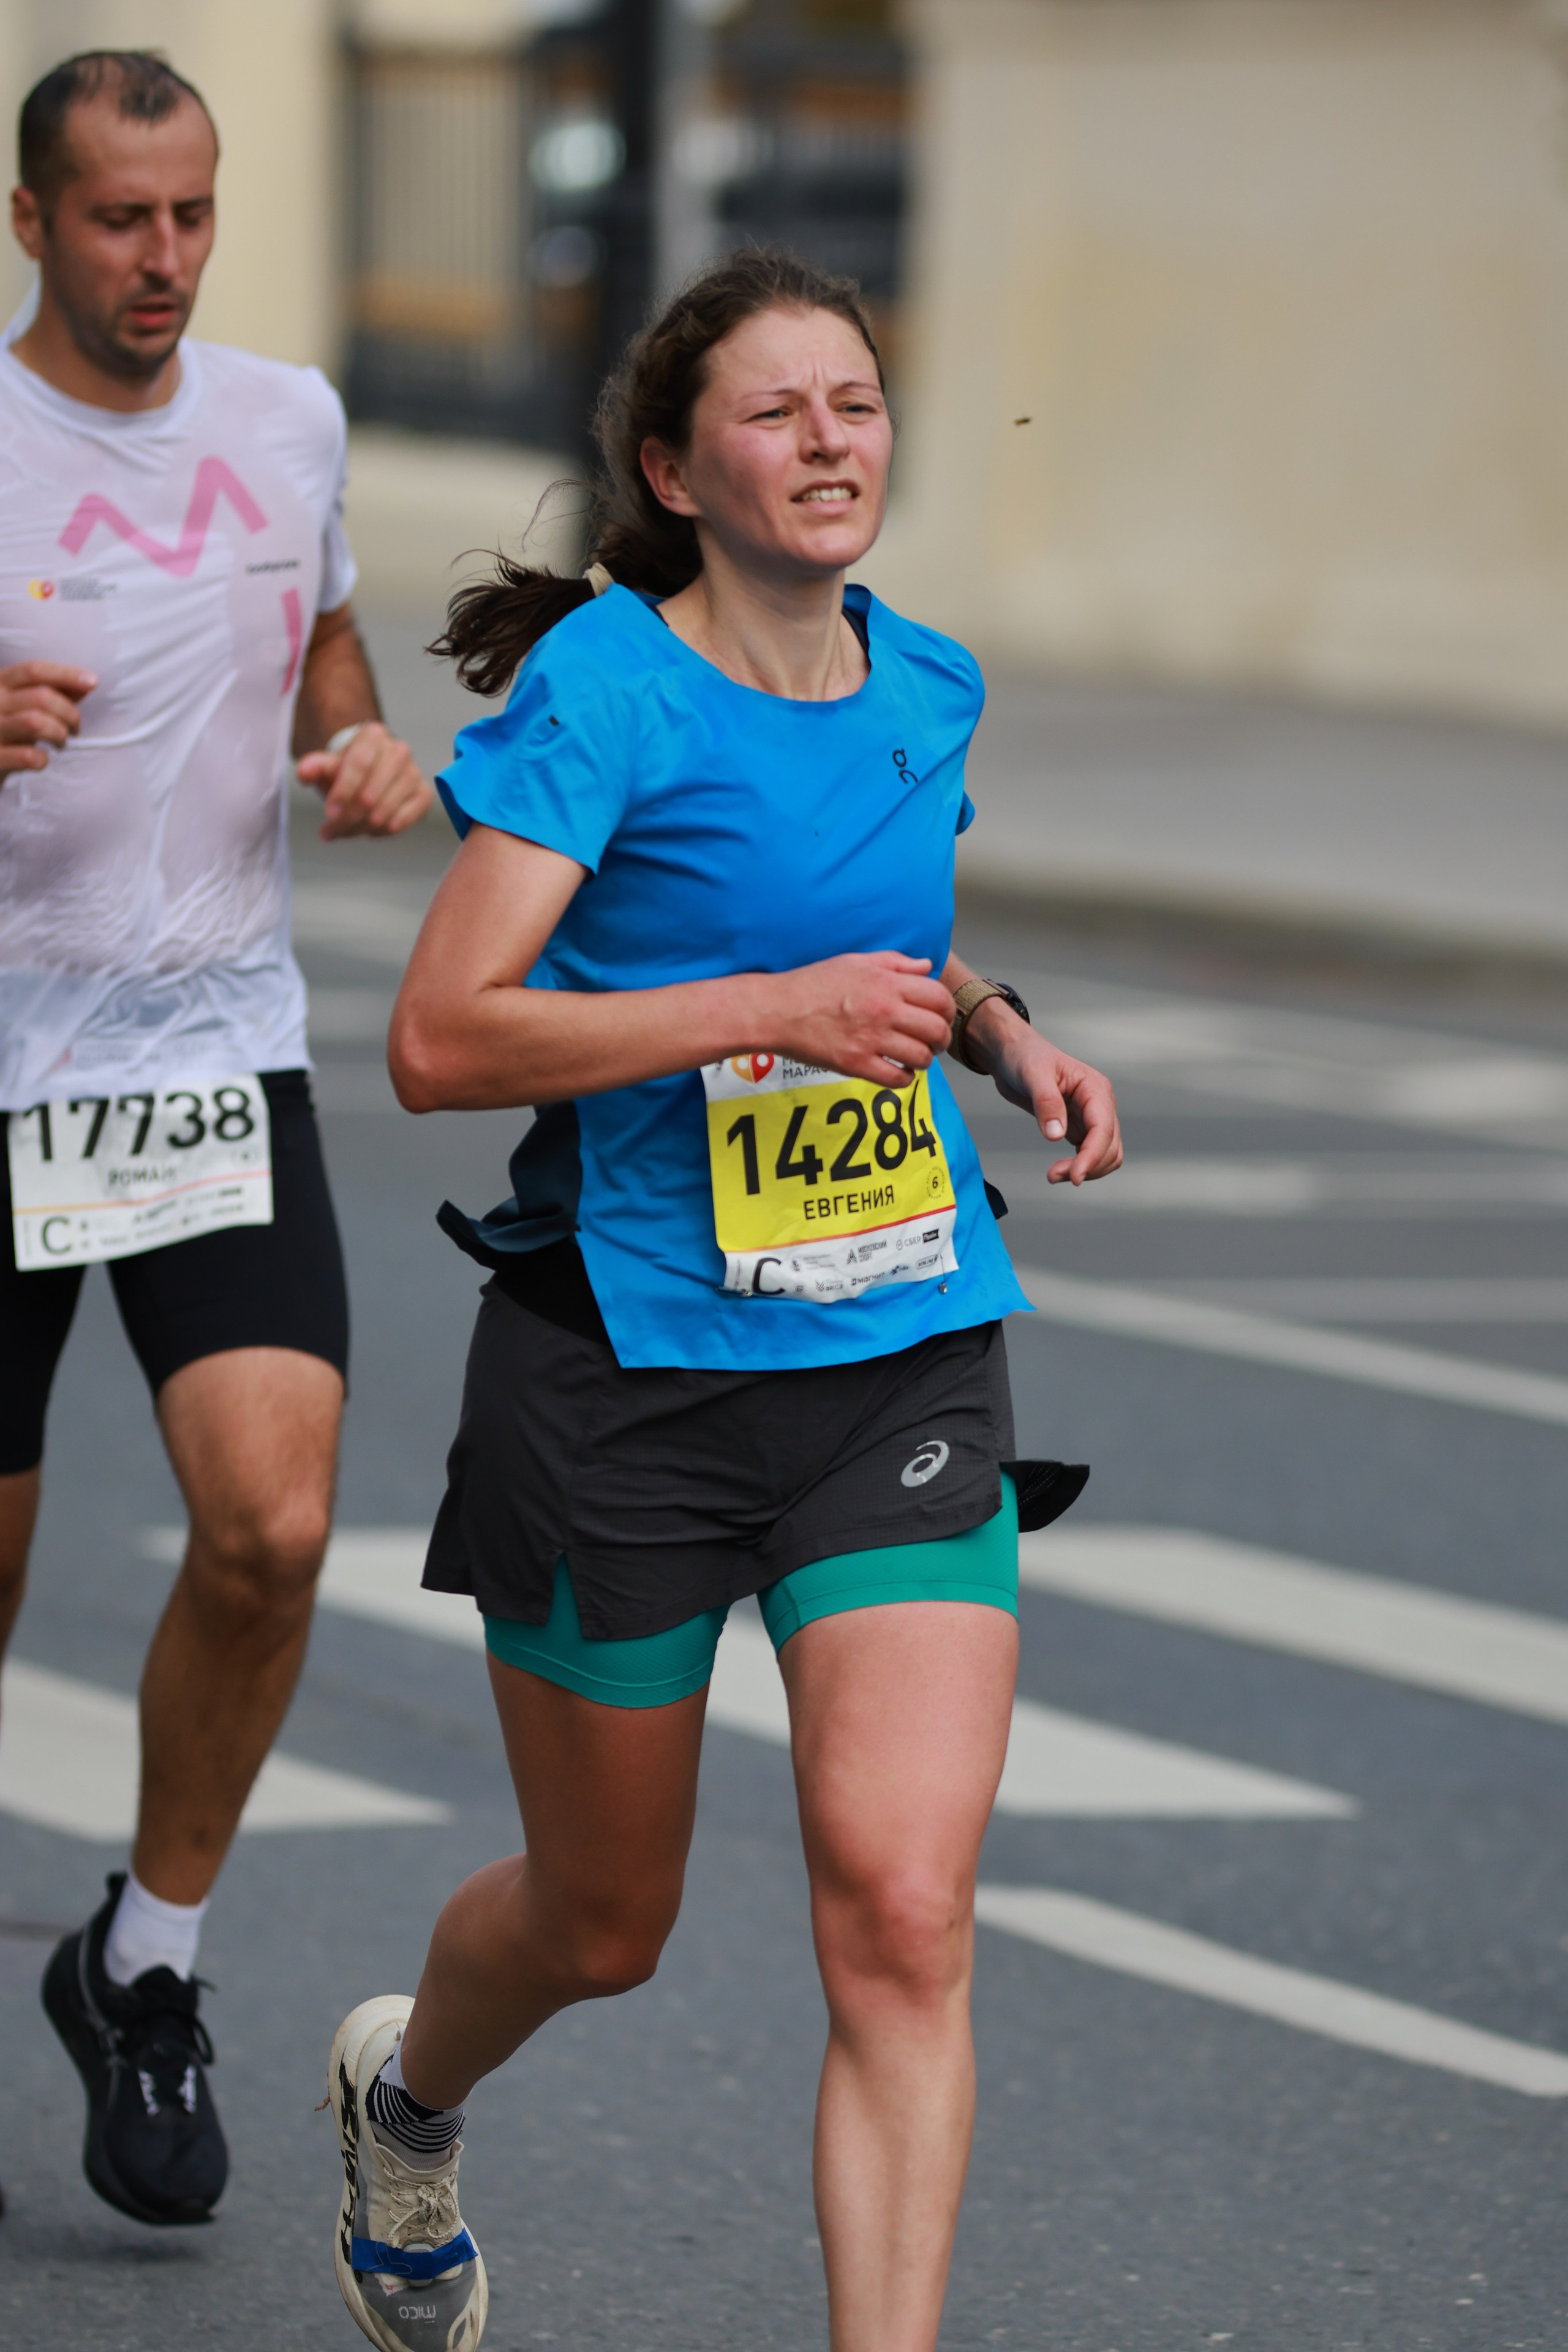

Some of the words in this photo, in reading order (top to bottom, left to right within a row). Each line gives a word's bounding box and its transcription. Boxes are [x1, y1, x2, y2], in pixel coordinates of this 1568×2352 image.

[23, 1087, 255, 1163] 17738
[726, 1079, 937, 1196] 14284
[932, 1175, 939, 1189] 6
[803, 1185, 895, 1221] ЕВГЕНИЯ
[904, 1235, 921, 1248] СБЕР
[859, 1252, 872, 1263] СПОРТ
